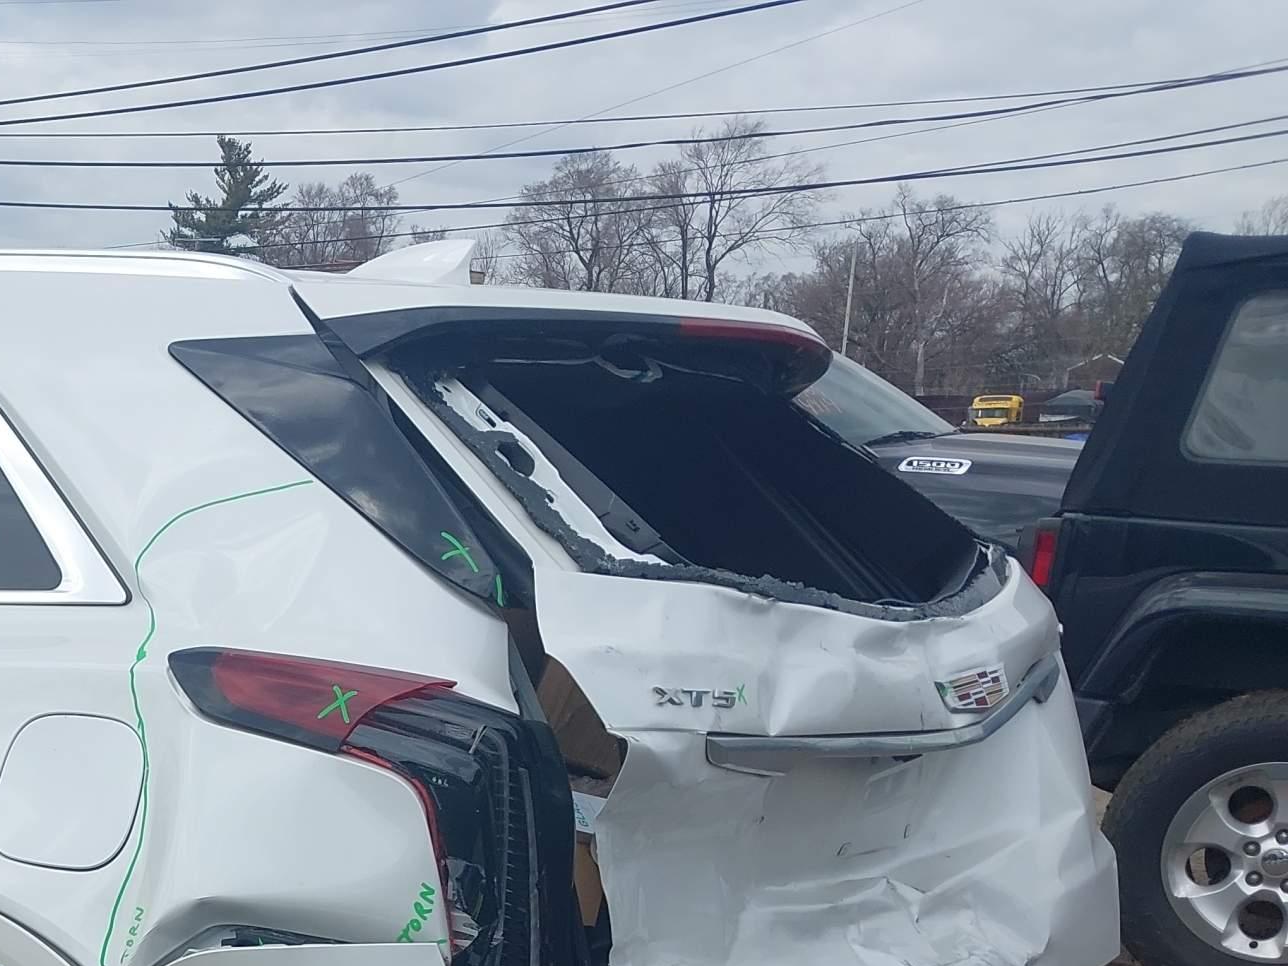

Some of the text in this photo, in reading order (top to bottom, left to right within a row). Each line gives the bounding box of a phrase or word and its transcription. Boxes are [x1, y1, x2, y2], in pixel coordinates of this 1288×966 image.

[652, 685, 737, 709] XT5
[120, 906, 144, 964] TORN
[396, 882, 436, 943] TORN
